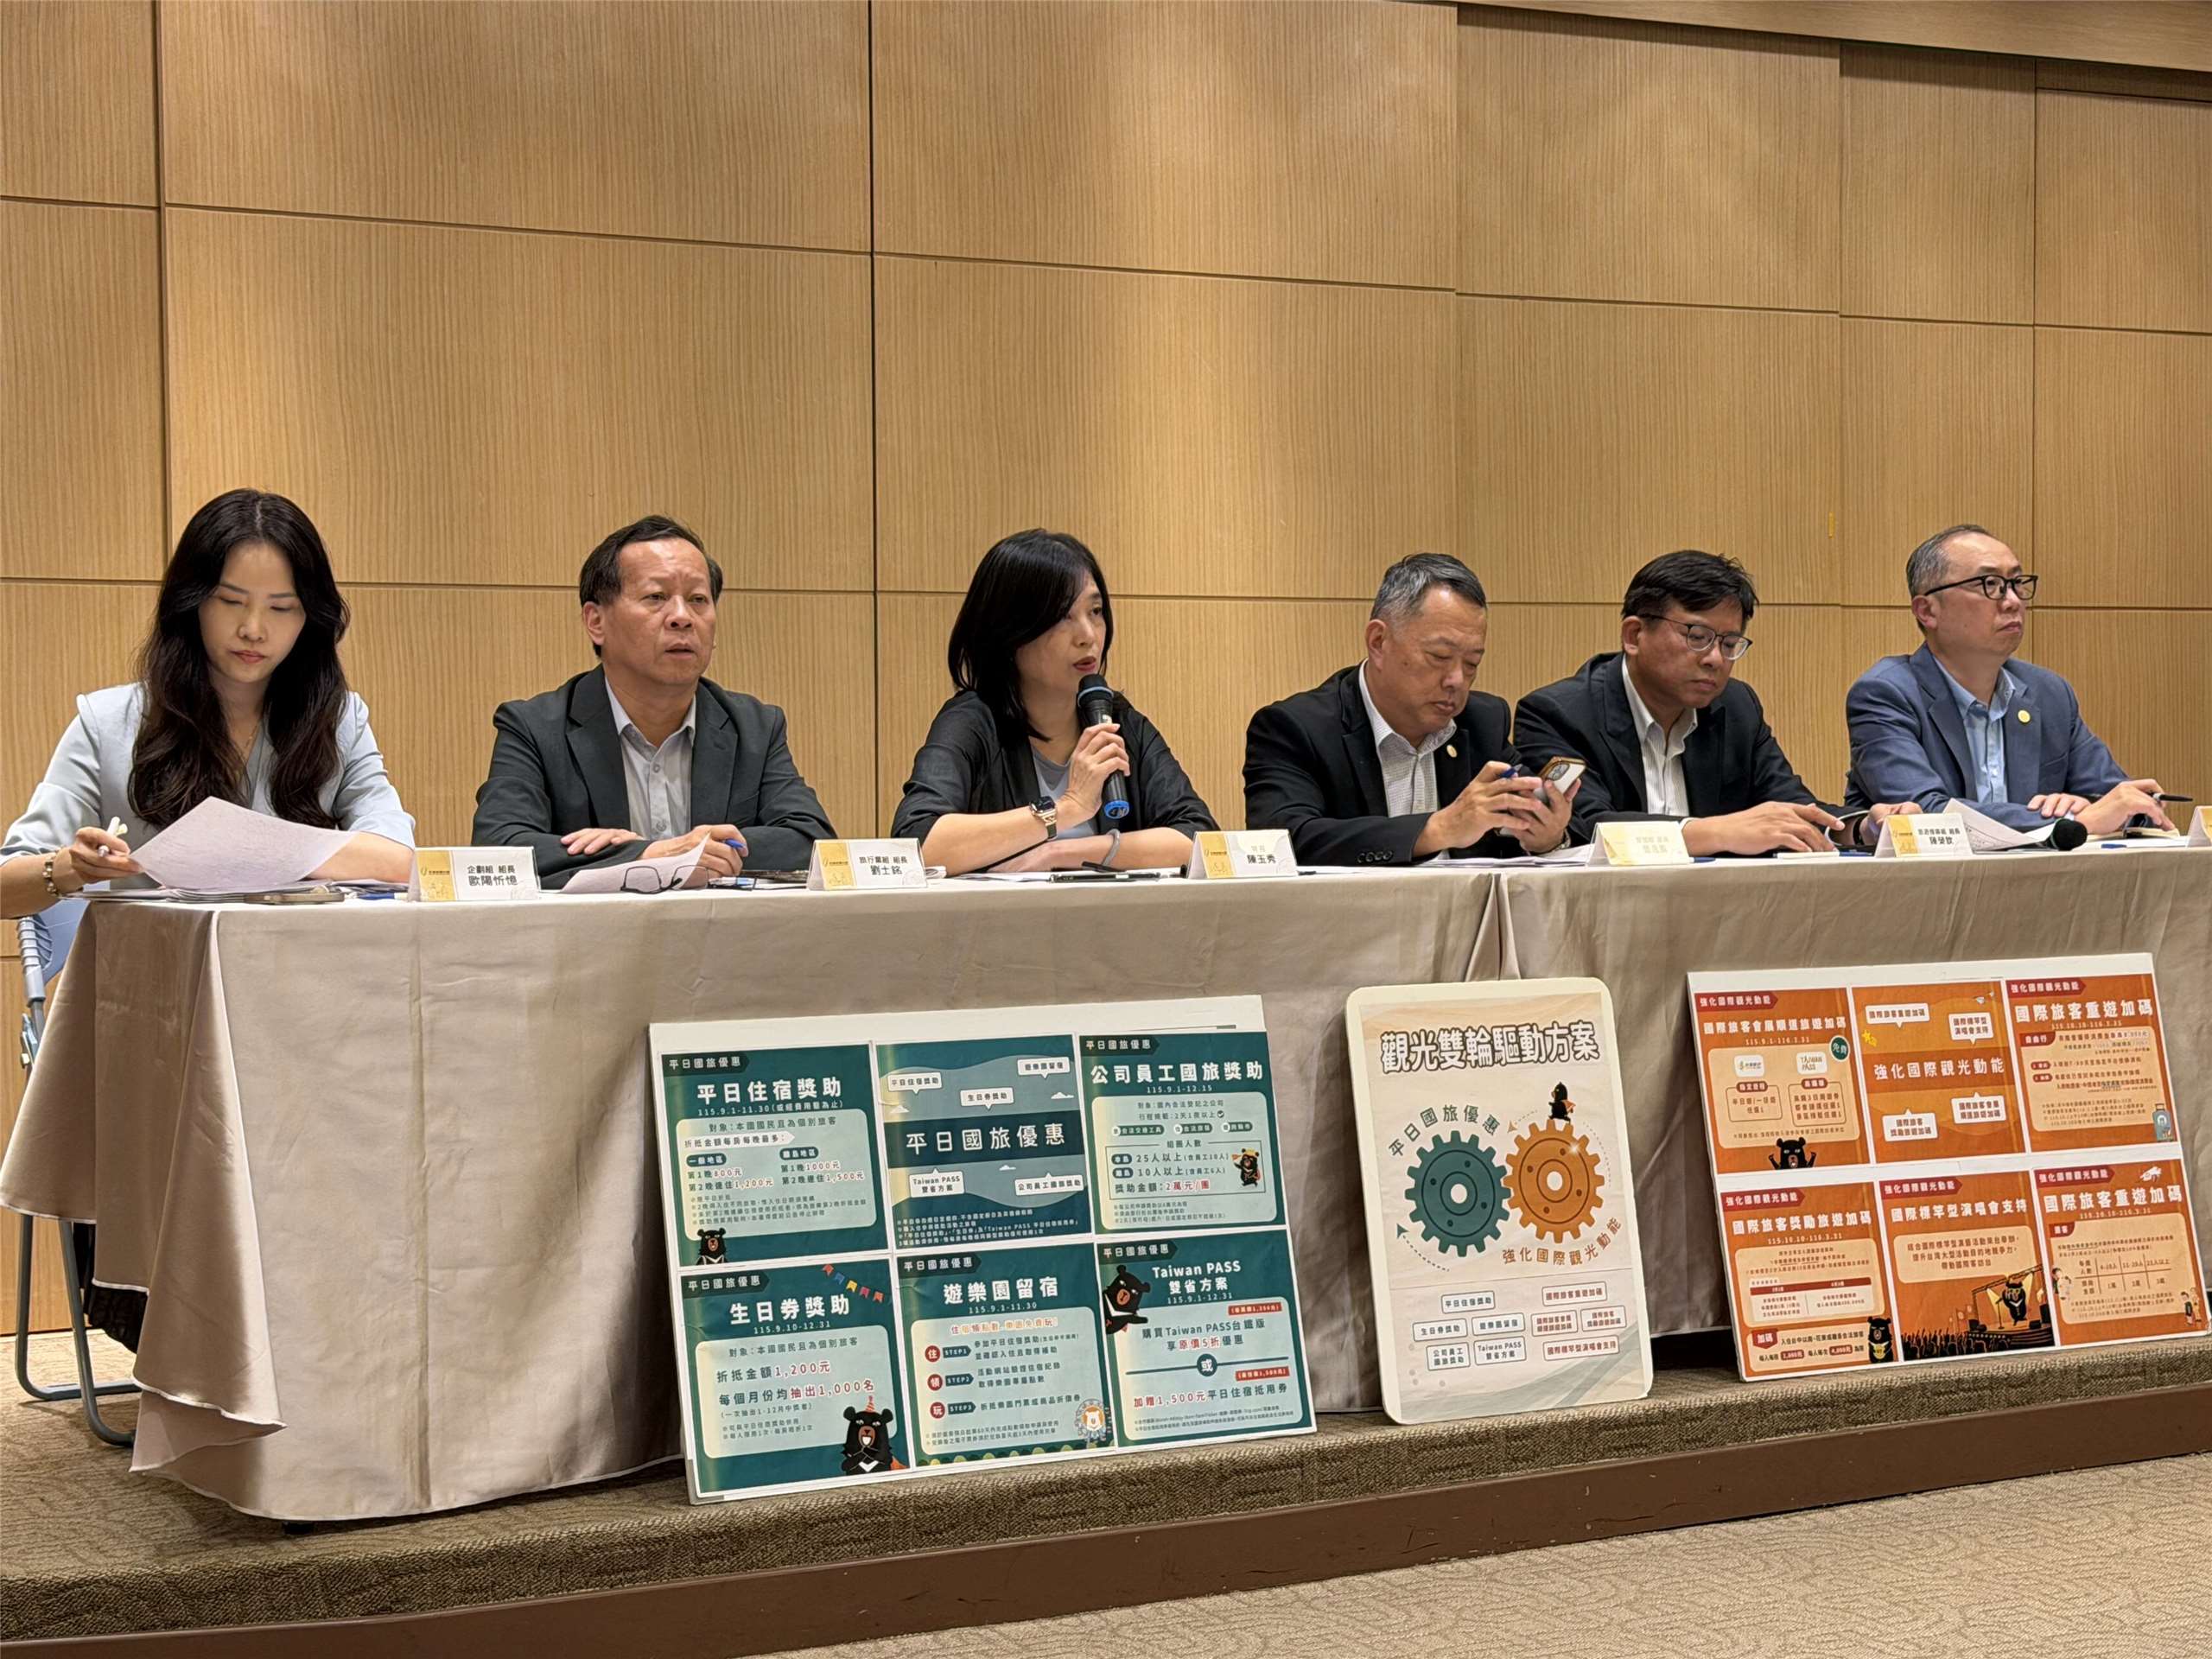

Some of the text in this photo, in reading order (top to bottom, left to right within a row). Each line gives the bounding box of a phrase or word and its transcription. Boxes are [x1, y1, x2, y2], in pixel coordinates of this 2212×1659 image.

[1247, 854, 1276, 864] 陳玉秀
[467, 865, 515, 874] 企劃組 組長
[870, 865, 902, 876] 劉士銘
[2010, 981, 2080, 993] 強化國際觀光動能
[1699, 995, 1770, 1007] 強化國際觀光動能
[2013, 998, 2154, 1022] 國際旅客重遊加碼
[1702, 1016, 1847, 1035] 國際旅客會展順道旅遊加碼
[1954, 1026, 1988, 1034] 演唱會支持
[1085, 1039, 1151, 1051] 平日國旅優惠
[1378, 1019, 1600, 1073] 觀光雙輪驅動方案
[1831, 1043, 1848, 1054] 免費
[669, 1056, 741, 1070] 平日國旅優惠
[1873, 1057, 2005, 1080] 強化國際觀光動能
[1090, 1060, 1263, 1084] 公司員工國旅獎助
[891, 1077, 938, 1086] 平日住宿獎助
[696, 1076, 842, 1105] 平日住宿獎助
[1147, 1084, 1212, 1094] 115.9.1-12.15
[967, 1092, 1007, 1102] 生日券獎助
[1896, 1117, 1923, 1127] 國際旅客
[1389, 1103, 1501, 1157] 平日國旅優惠
[905, 1122, 1065, 1155] 平日國旅優惠
[1166, 1139, 1201, 1148] 組團人數
[781, 1148, 816, 1158] 離島地區
[688, 1155, 723, 1165] 一般地區
[780, 1160, 840, 1173] 第1晚1000元
[2038, 1168, 2108, 1183] 強化國際觀光動能
[921, 1185, 953, 1193] 雙省方案
[1018, 1179, 1081, 1190] 公司員工國旅獎助
[1884, 1179, 1955, 1194] 強化國際觀光動能
[1725, 1191, 1798, 1206] 強化國際觀光動能
[2043, 1185, 2183, 1212] 國際旅客重遊加碼
[1890, 1198, 2028, 1223] 國際標竿型演唱會支持
[1732, 1210, 1872, 1235] 國際旅客獎勵旅遊加碼
[1502, 1217, 1621, 1266] 強化國際觀光動能
[1103, 1243, 1169, 1258] 平日國旅優惠
[903, 1256, 972, 1272] 平日國旅優惠
[1151, 1260, 1242, 1278] Taiwan PASS
[687, 1275, 760, 1291] 平日國旅優惠
[1168, 1276, 1229, 1294] 雙省方案
[943, 1275, 1058, 1305] 遊樂園留宿
[1166, 1292, 1232, 1304] 115.9.1-12.31
[1445, 1297, 1491, 1308] 平日住宿獎助
[728, 1294, 850, 1325] 生日券獎助
[969, 1301, 1037, 1313] 115.9.1-11.30
[753, 1320, 830, 1334] 115.9.10-12.31
[1141, 1318, 1266, 1339] 購買Taiwan PASS台鐵版
[1421, 1325, 1460, 1336] 生日券獎助
[1479, 1319, 1518, 1330] 遊樂園留宿
[1166, 1334, 1243, 1351] 享原價5折優惠
[1757, 1332, 1774, 1343] 加碼
[944, 1347, 967, 1356] STEP1
[1433, 1347, 1464, 1357] 公司員工
[1478, 1340, 1522, 1351] Taiwan PASS
[927, 1348, 938, 1360] 住
[716, 1361, 830, 1382] 折抵金額1,200元
[1200, 1358, 1213, 1372] 或
[929, 1376, 941, 1388] 領
[947, 1376, 969, 1384] STEP2
[718, 1379, 874, 1406] 每個月份均抽出1,000名
[1133, 1382, 1287, 1408] 加贈1,500元平日住宿抵用券
[931, 1404, 943, 1415] 玩
